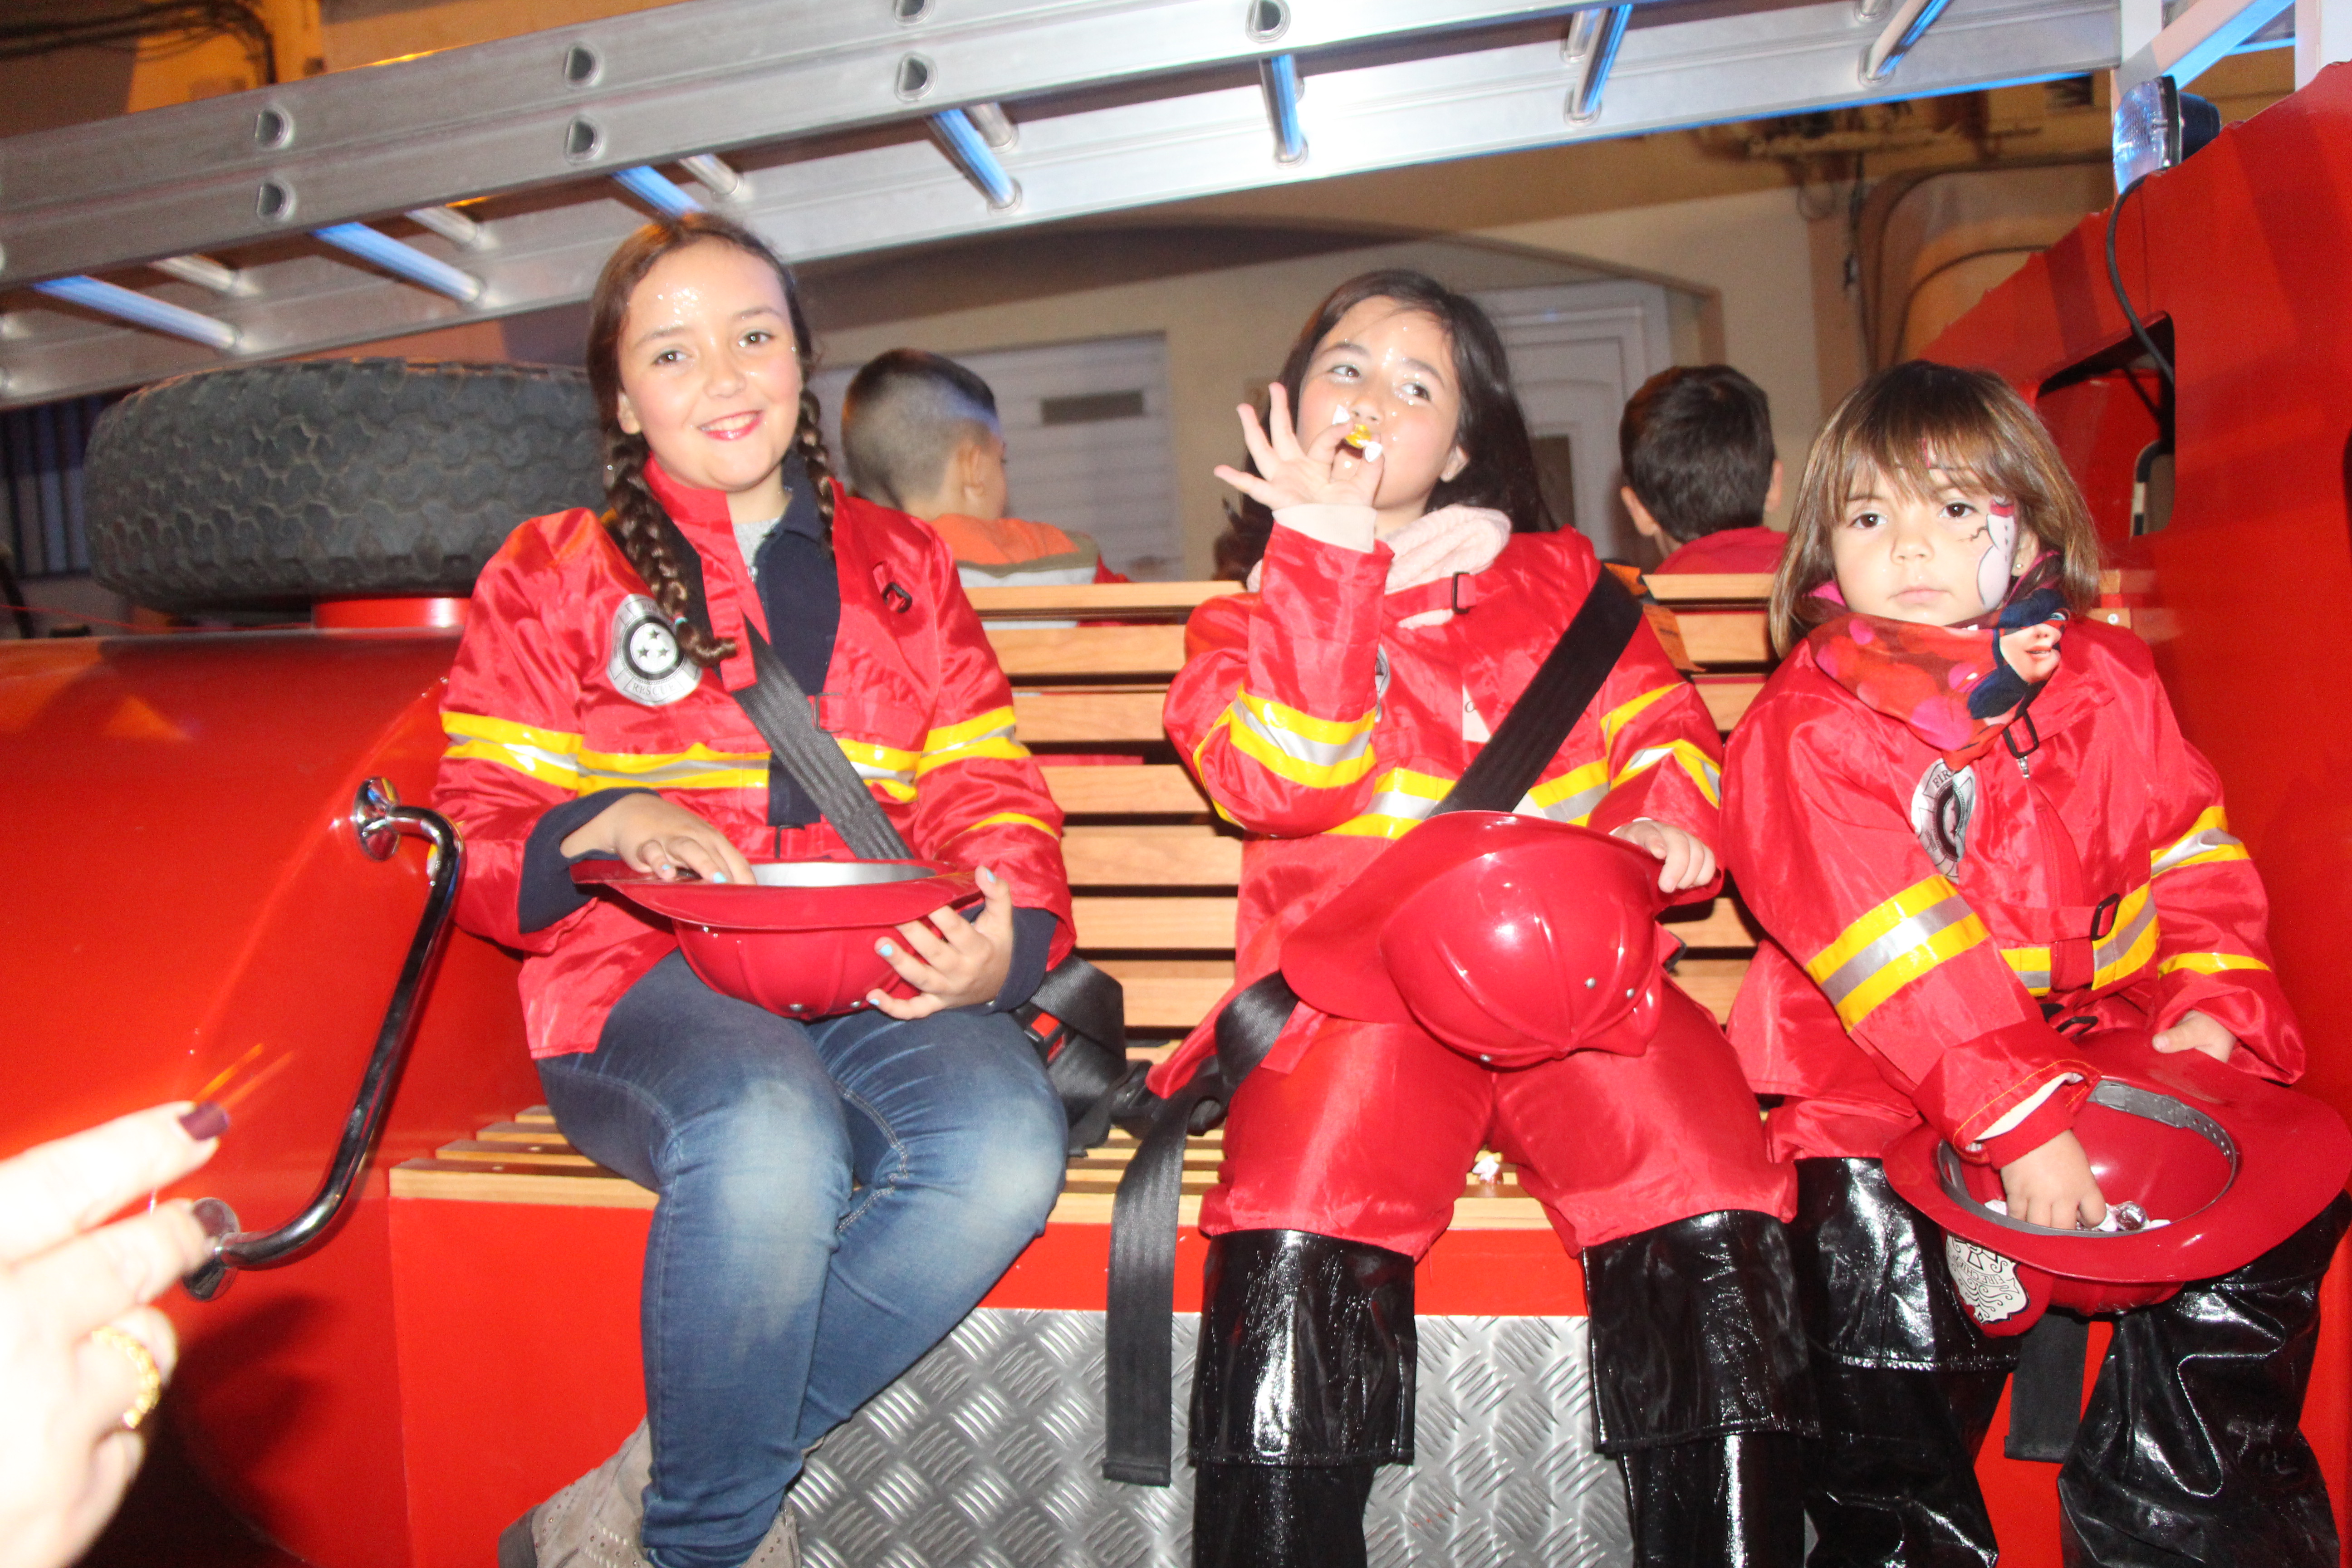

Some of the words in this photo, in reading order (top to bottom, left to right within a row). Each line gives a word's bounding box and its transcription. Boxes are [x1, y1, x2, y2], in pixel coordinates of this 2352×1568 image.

[632, 683, 676, 695] RESCUE
[1932, 769, 1951, 788] FIR
[1980, 1274, 2006, 1284] FIRE
